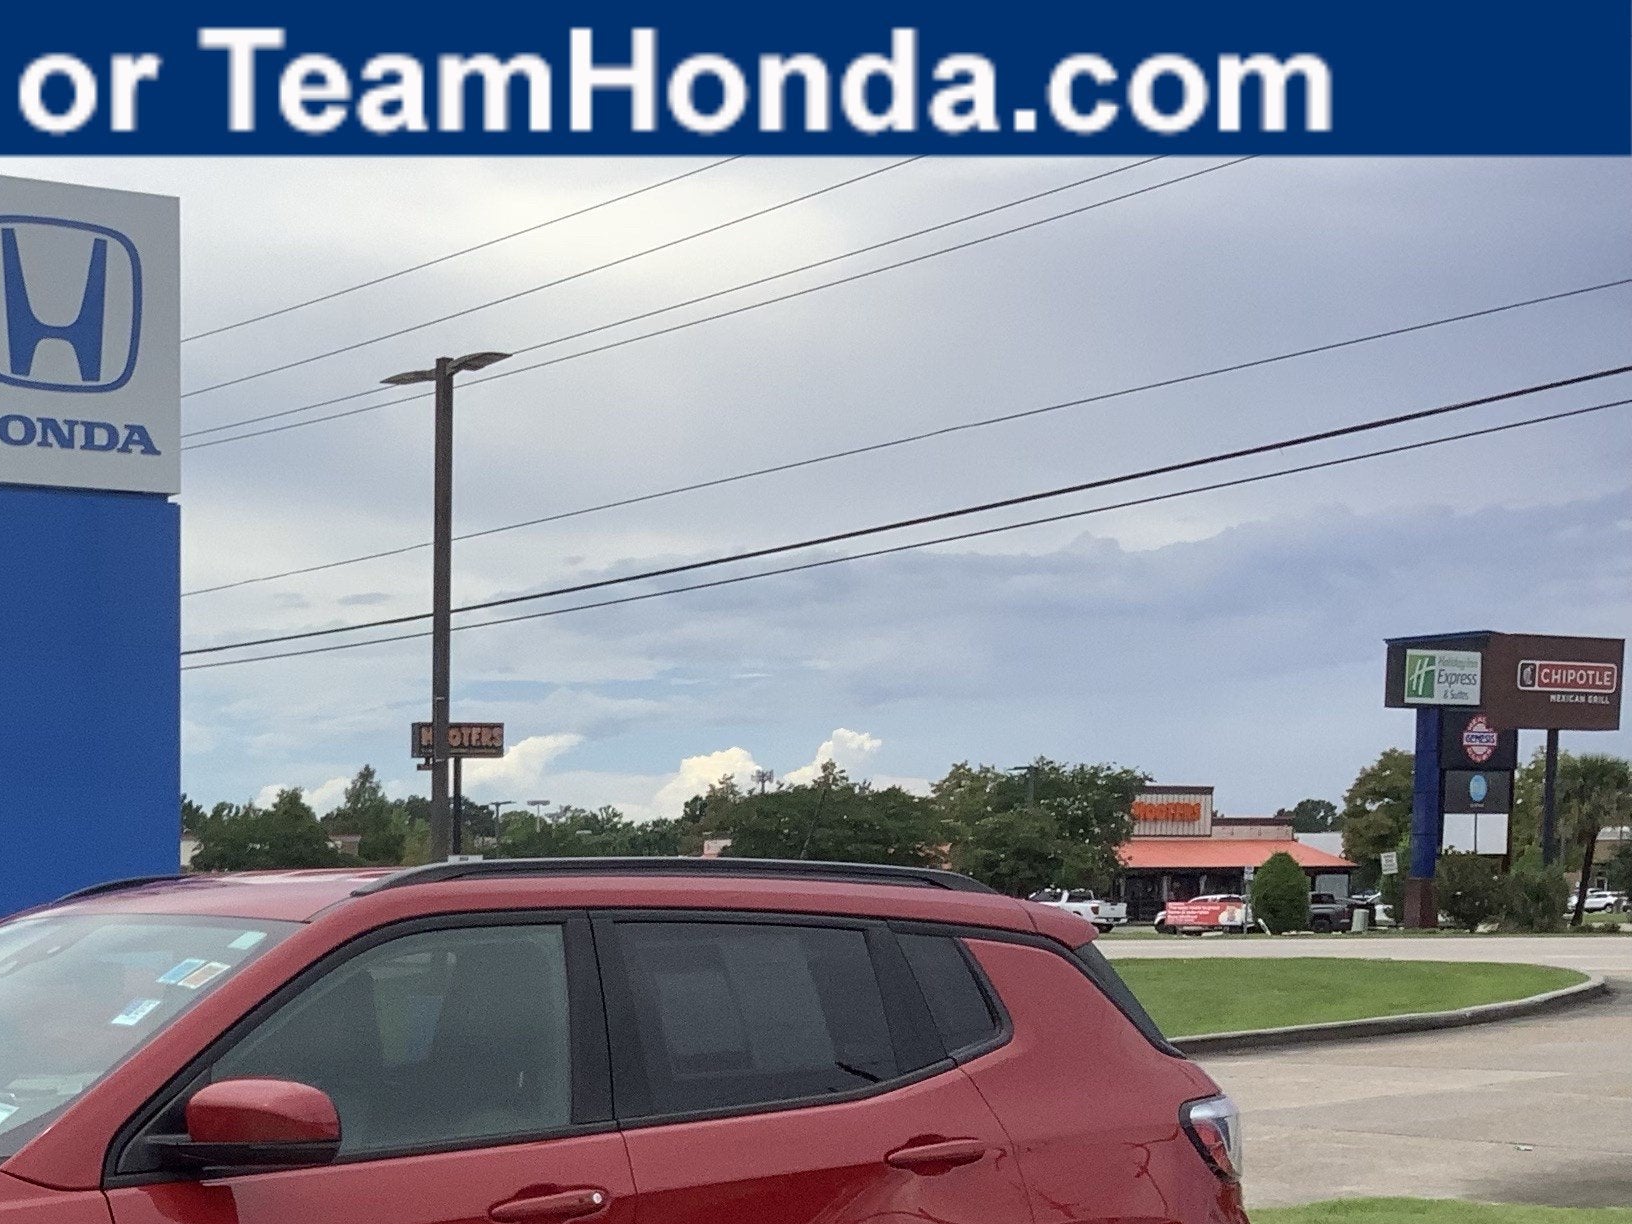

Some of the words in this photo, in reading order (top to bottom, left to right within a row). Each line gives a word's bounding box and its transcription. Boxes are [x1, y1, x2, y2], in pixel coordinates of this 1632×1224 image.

[1437, 668, 1478, 688] Express
[1540, 668, 1613, 686] CHIPOTLE
[1549, 693, 1586, 703] MEXICAN
[421, 726, 503, 747] HOTERS
